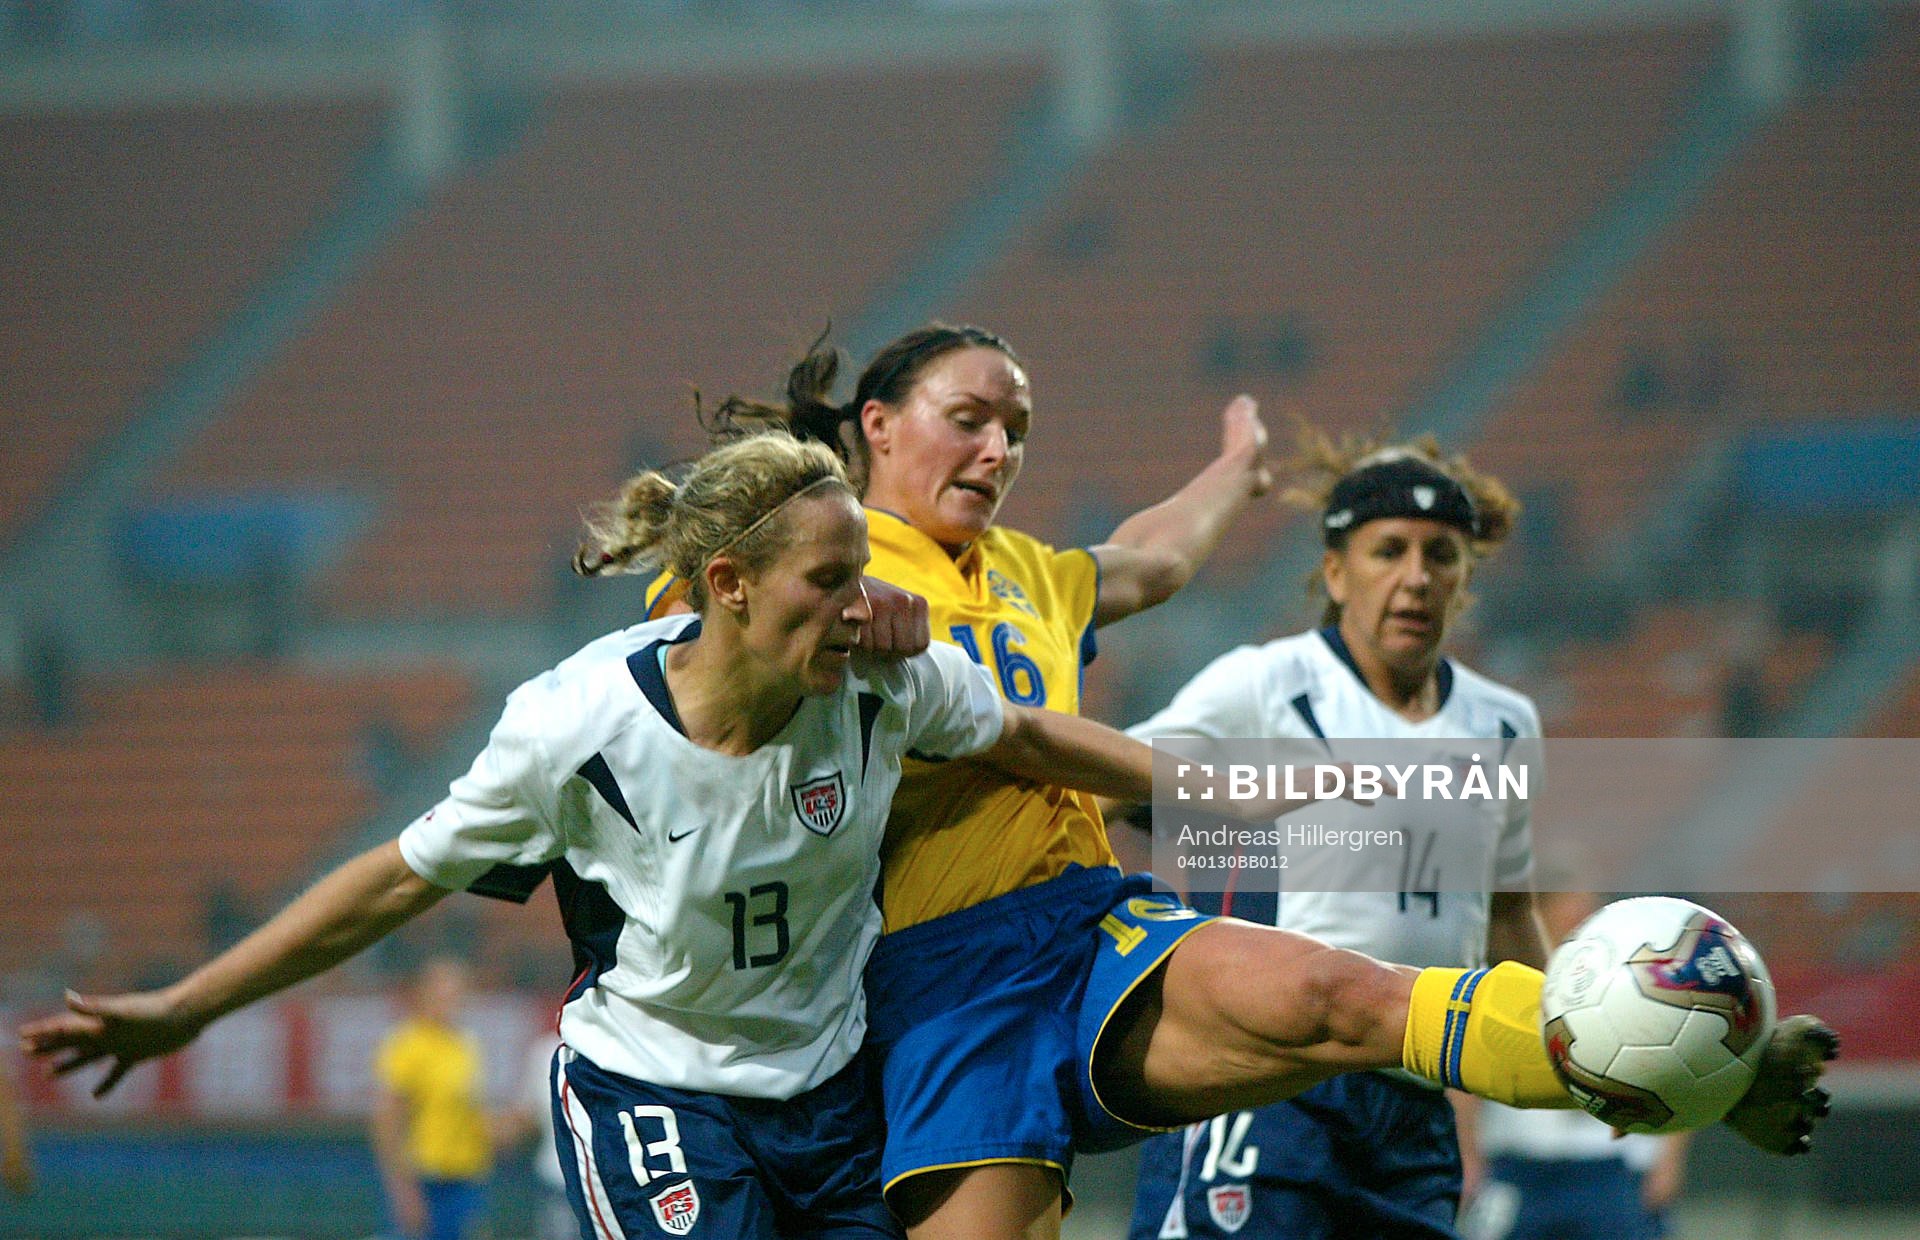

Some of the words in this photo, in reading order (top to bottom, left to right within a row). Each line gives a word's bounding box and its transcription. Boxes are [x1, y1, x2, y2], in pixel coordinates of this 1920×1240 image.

[949, 621, 1046, 708] 16
[1397, 827, 1440, 919] 14
[724, 881, 790, 971] 13
[617, 1105, 687, 1187] 13
[1200, 1110, 1259, 1182] 14
